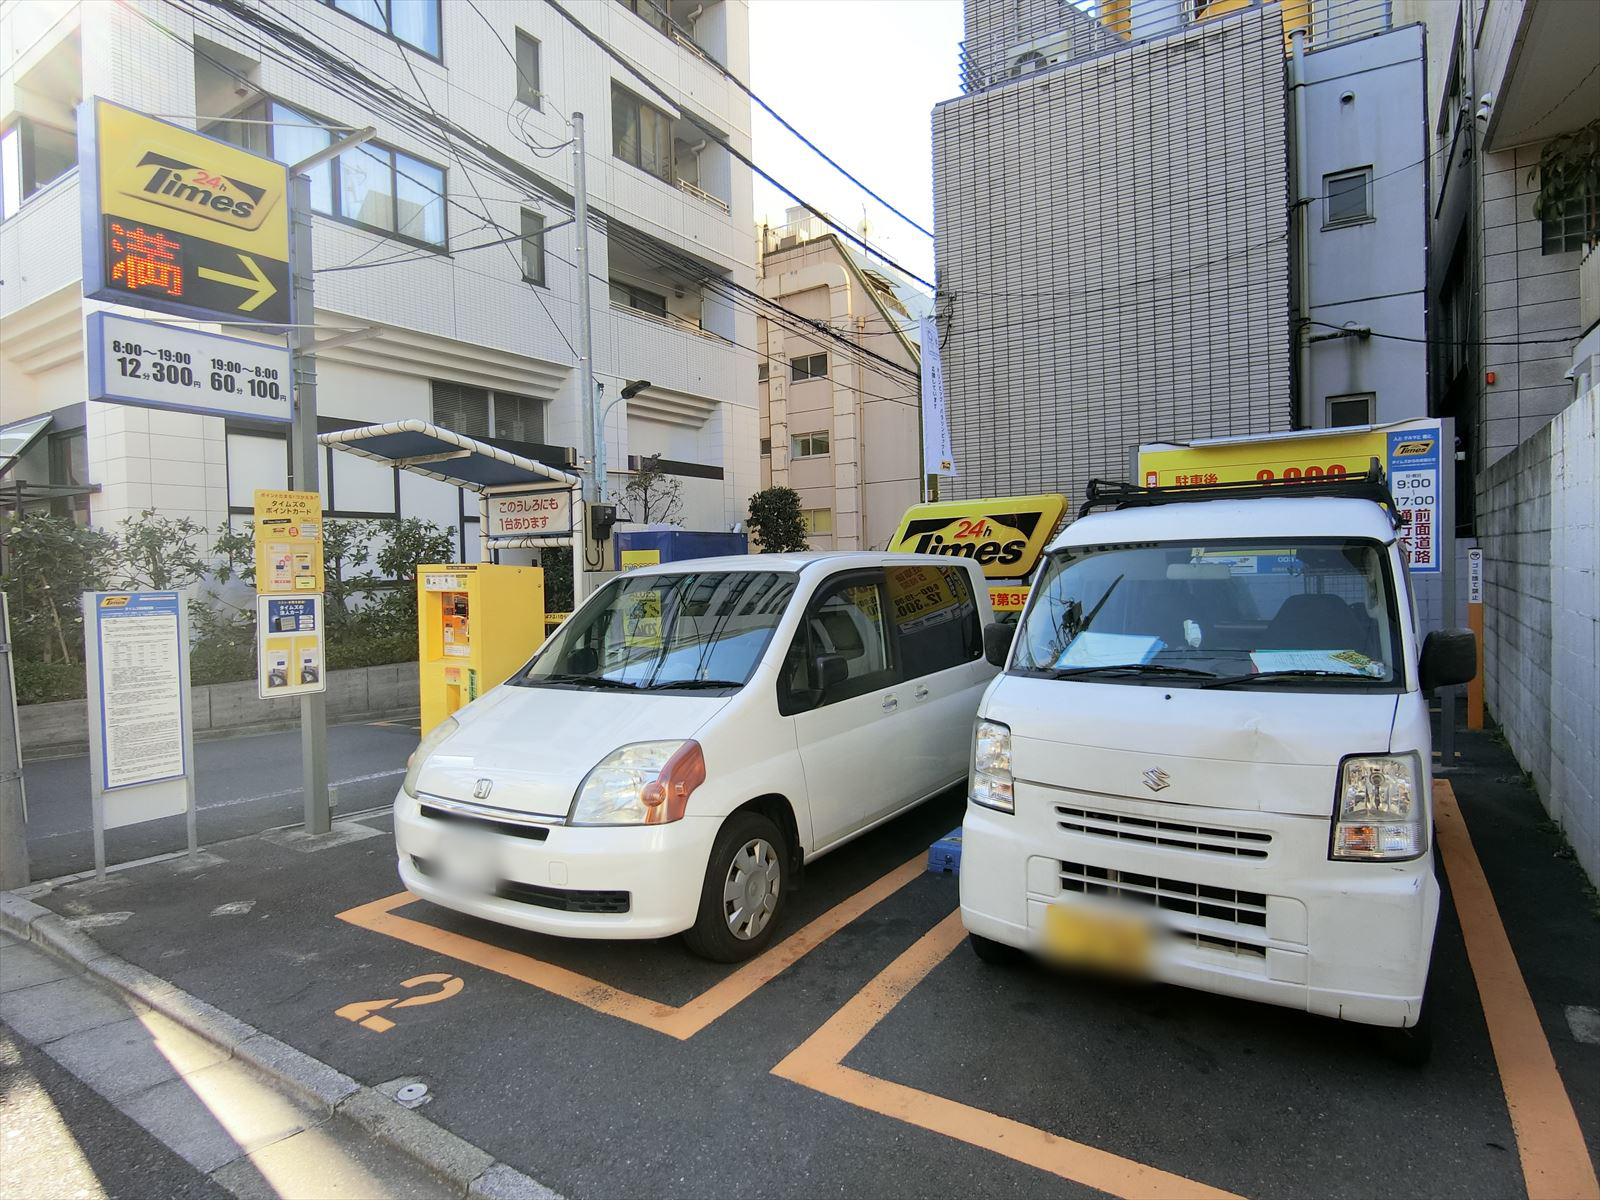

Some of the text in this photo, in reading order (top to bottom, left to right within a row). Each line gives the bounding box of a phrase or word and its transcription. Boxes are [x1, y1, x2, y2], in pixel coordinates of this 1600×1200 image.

[192, 170, 227, 192] 24h
[144, 168, 254, 218] Times
[112, 223, 183, 297] 満
[1175, 473, 1218, 486] 駐車後
[1397, 479, 1431, 489] 9:00
[271, 500, 306, 508] タイムズの
[499, 497, 559, 513] このうしろにも
[1394, 496, 1434, 506] 17:00
[266, 507, 312, 515] ポイントカード
[499, 515, 549, 531] 1台あります
[954, 519, 992, 539] 24h
[1414, 508, 1431, 564] 前面道路
[335, 973, 464, 1032] 2
